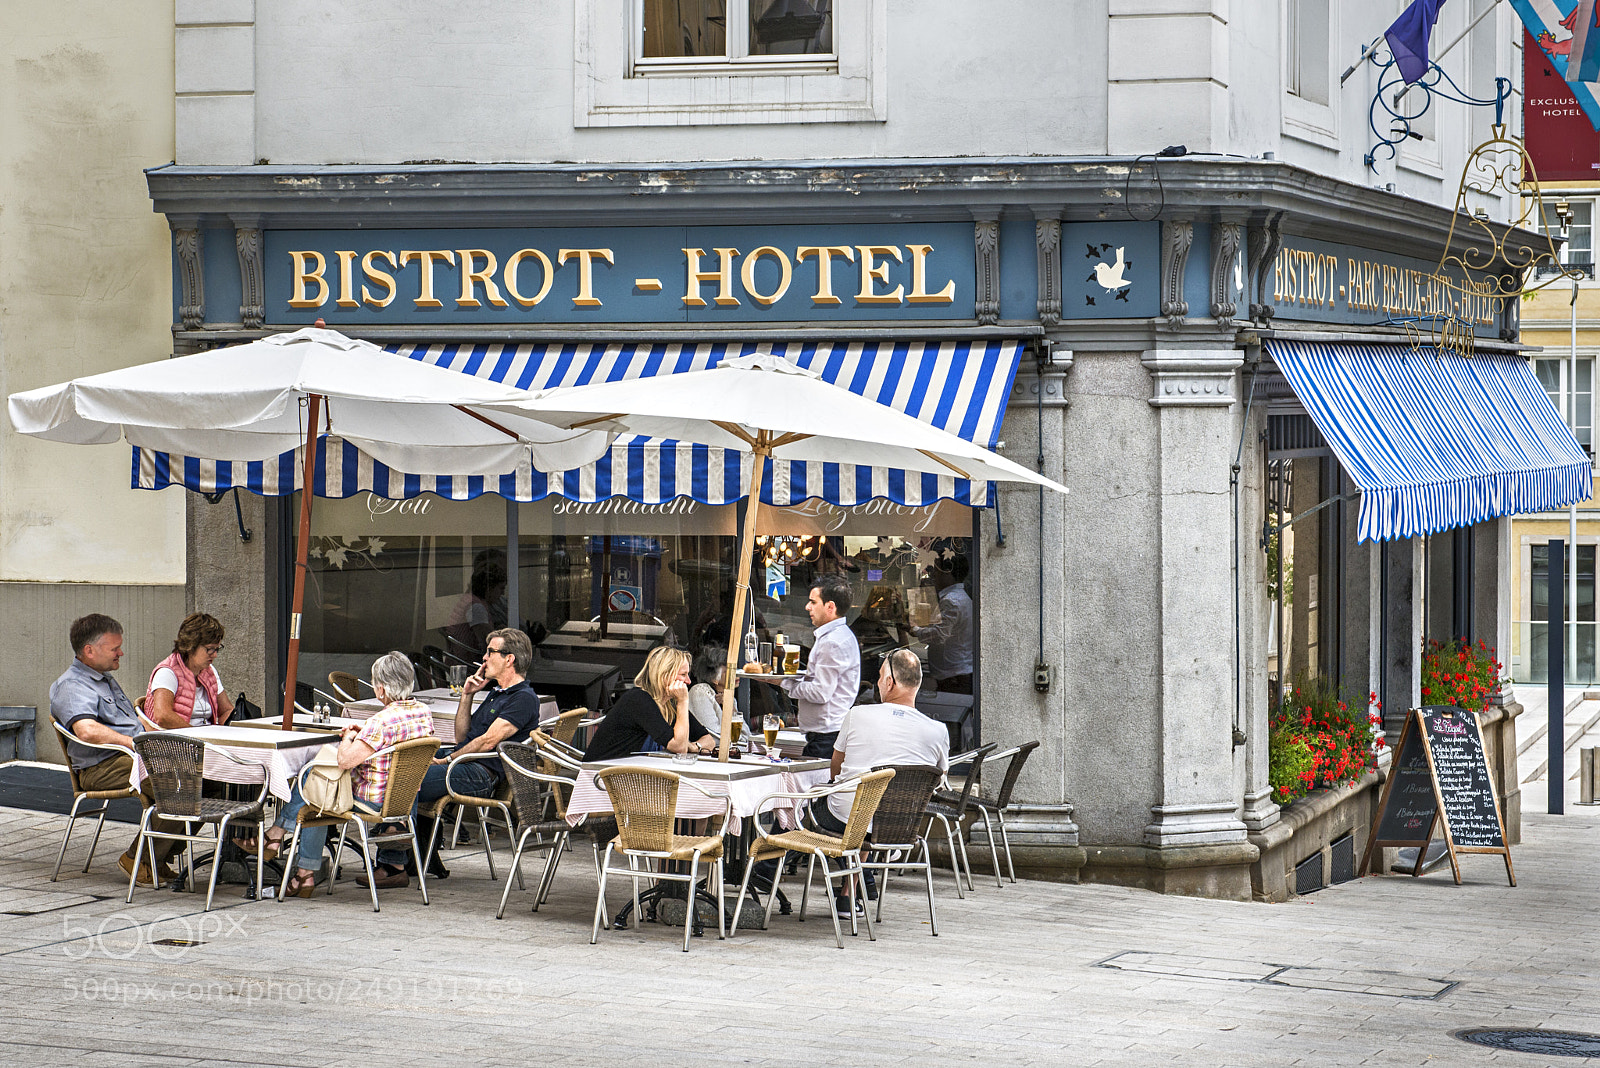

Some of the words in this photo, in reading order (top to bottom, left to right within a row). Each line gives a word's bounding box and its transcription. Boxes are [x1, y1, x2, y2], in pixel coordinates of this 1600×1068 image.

[1530, 97, 1579, 105] EXCLUS
[1543, 108, 1581, 116] HOTEL
[288, 248, 614, 307] BISTROT
[681, 244, 955, 307] HOTEL
[1273, 247, 1337, 307] BISTROT
[1347, 258, 1380, 311] PARC
[1382, 264, 1453, 317] BEAUX-ARTS
[1461, 279, 1494, 325] HOTEL
